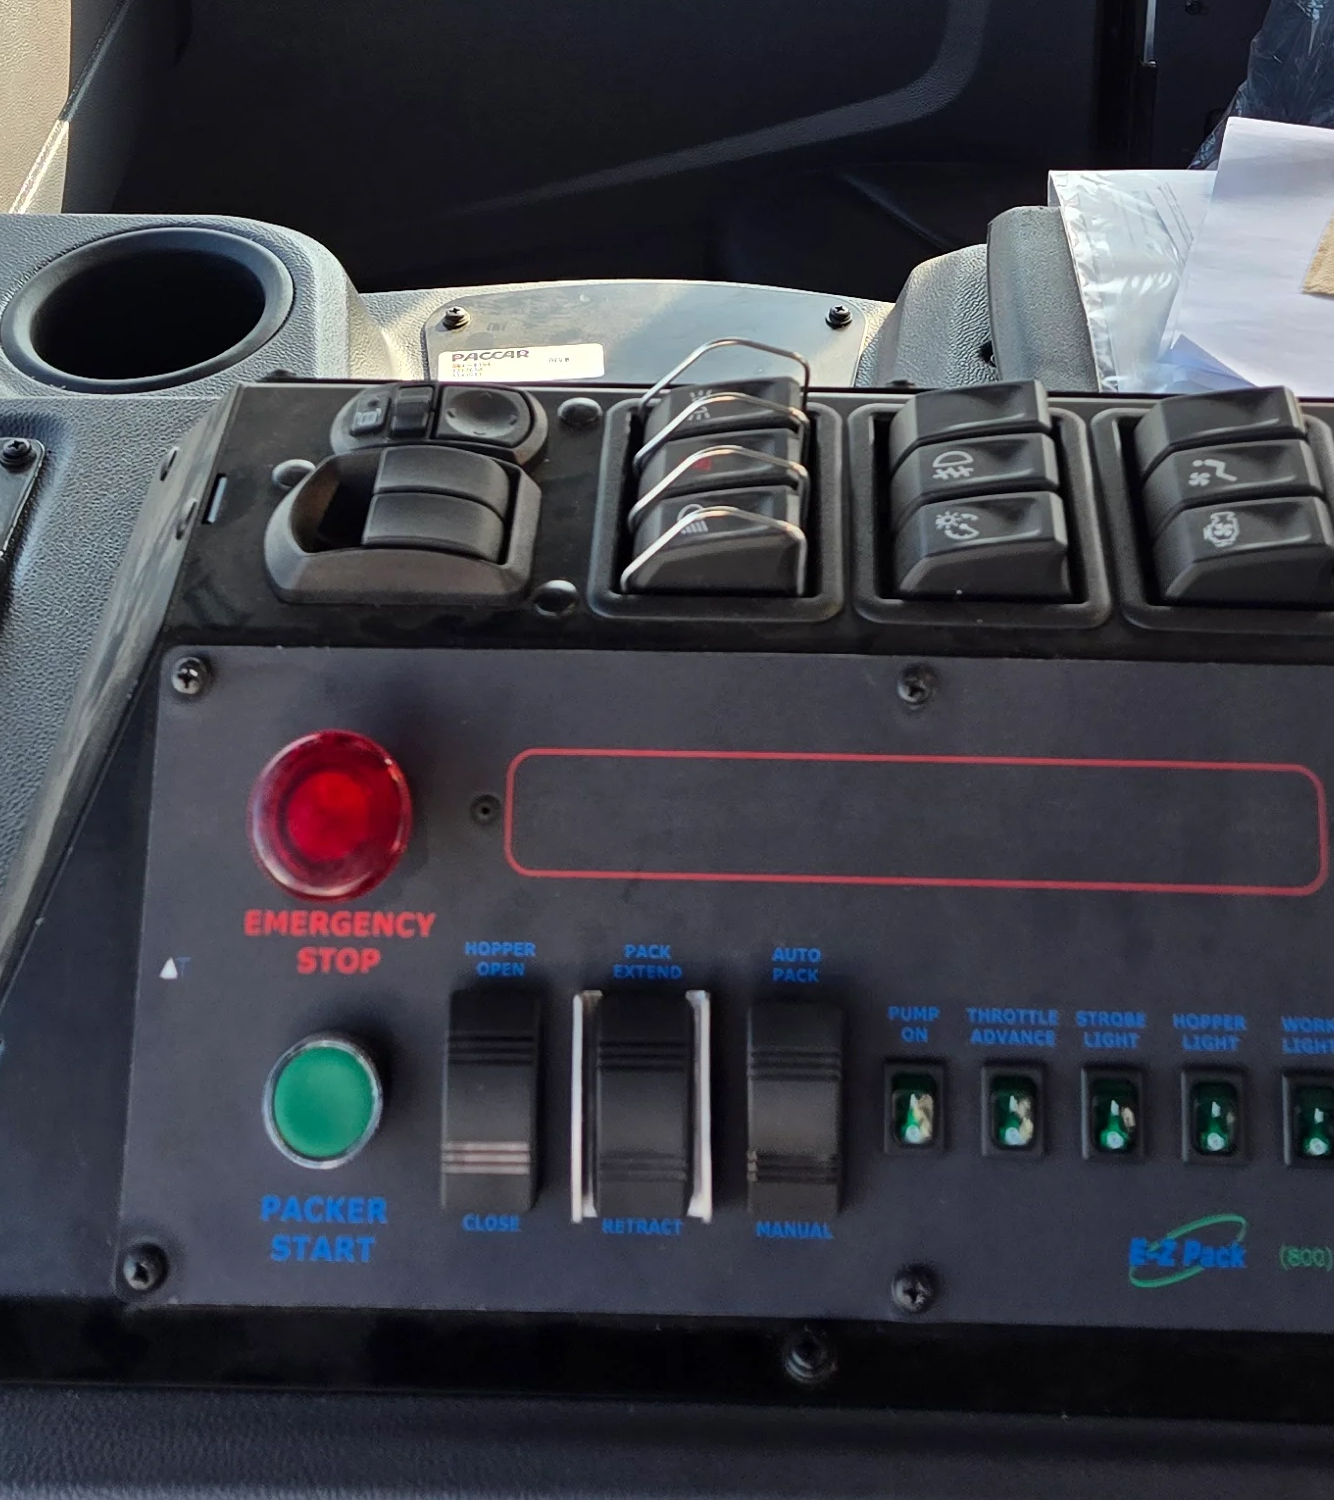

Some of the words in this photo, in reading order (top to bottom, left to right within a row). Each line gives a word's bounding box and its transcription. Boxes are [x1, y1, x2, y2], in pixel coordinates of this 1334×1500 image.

[452, 350, 529, 361] PACCAR
[243, 908, 437, 938] EMERGENCY
[464, 941, 536, 957] HOPPER
[624, 943, 671, 959] PACK
[771, 947, 822, 963] AUTO
[296, 946, 381, 975] STOP
[475, 961, 525, 978] OPEN
[613, 963, 683, 981] EXTEND
[772, 967, 819, 983] PACK
[888, 1006, 940, 1021] PUMP
[967, 1007, 1060, 1026] THROTTLE
[1075, 1011, 1147, 1028] STROBE
[1172, 1013, 1247, 1032] HOPPER
[901, 1027, 929, 1043] ON
[970, 1028, 1056, 1047] ADVANCE
[1083, 1032, 1140, 1049] LIGHT
[1181, 1034, 1241, 1051] LIGHT
[259, 1195, 388, 1224] PACKER
[462, 1214, 521, 1232] CLOSE
[602, 1217, 683, 1236] RETRACT
[755, 1221, 834, 1239] MANUAL
[270, 1233, 376, 1263] START
[1183, 1240, 1248, 1269] Pack
[1279, 1244, 1333, 1273] (800)
